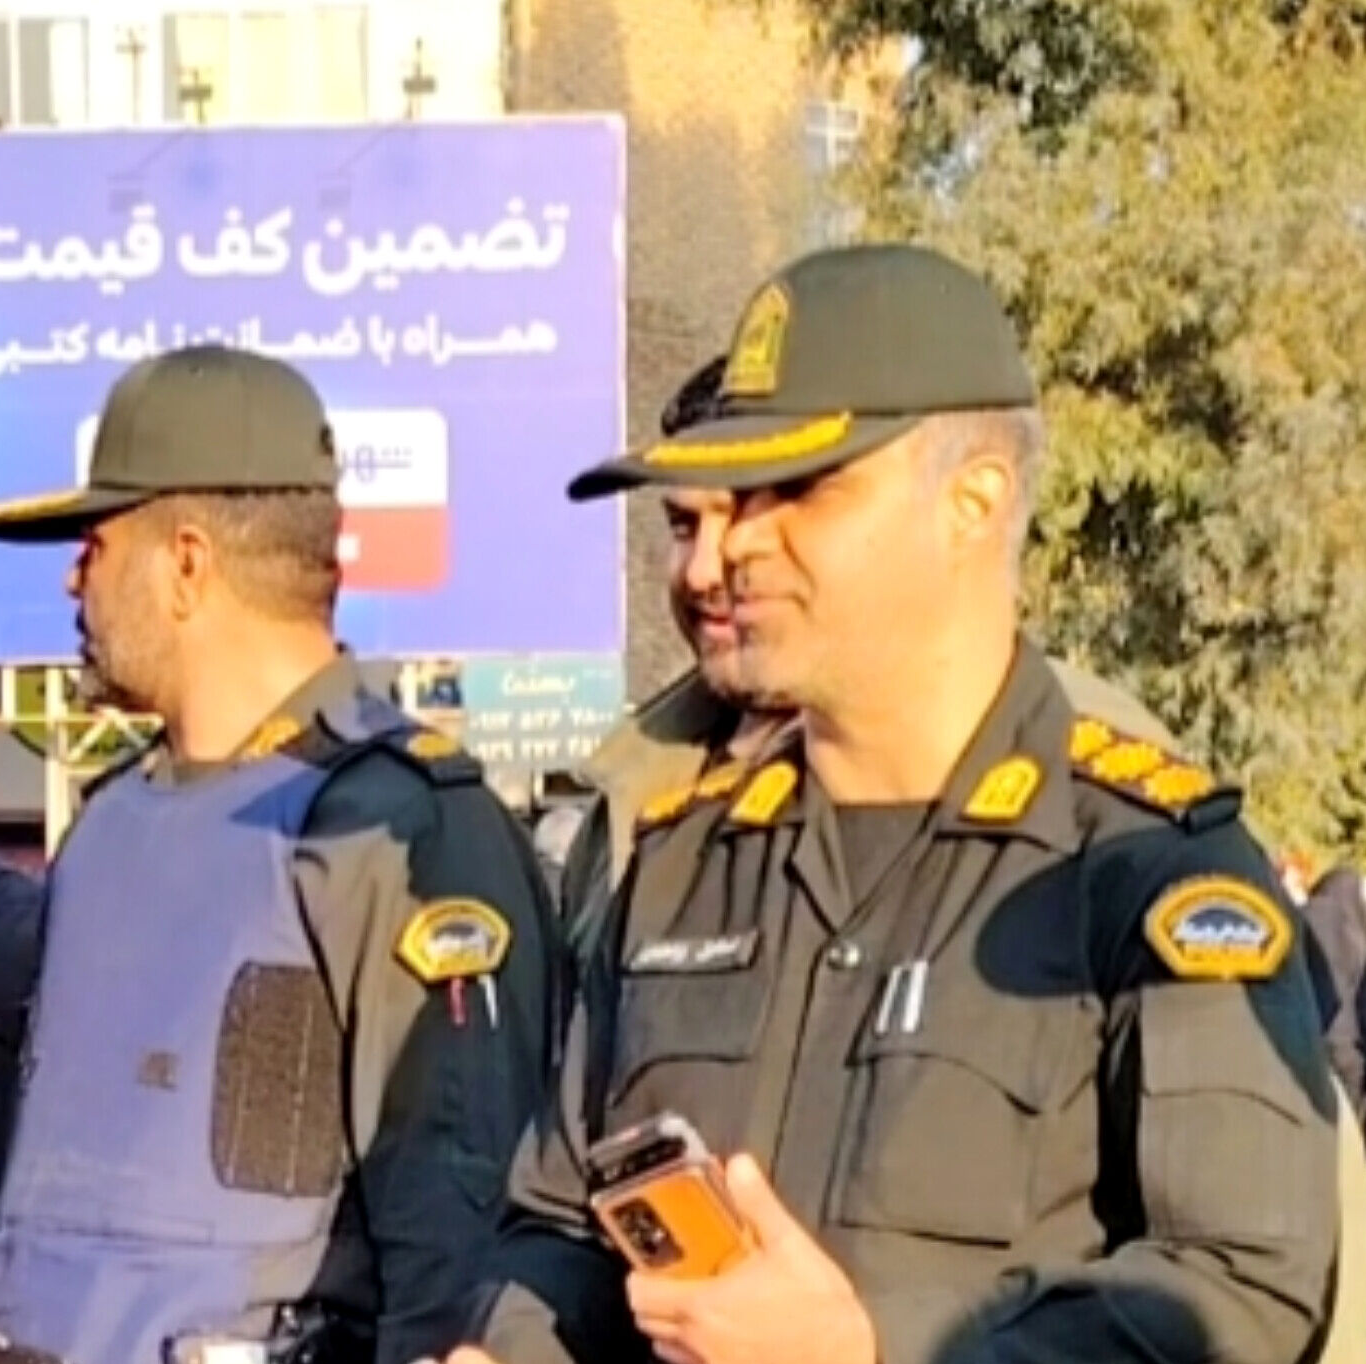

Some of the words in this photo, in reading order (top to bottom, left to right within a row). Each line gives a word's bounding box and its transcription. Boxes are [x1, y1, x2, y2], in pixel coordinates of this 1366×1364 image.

[178, 206, 294, 278] کف
[306, 197, 570, 294] تضمین
[367, 313, 396, 367] با
[402, 313, 557, 367] همراه
